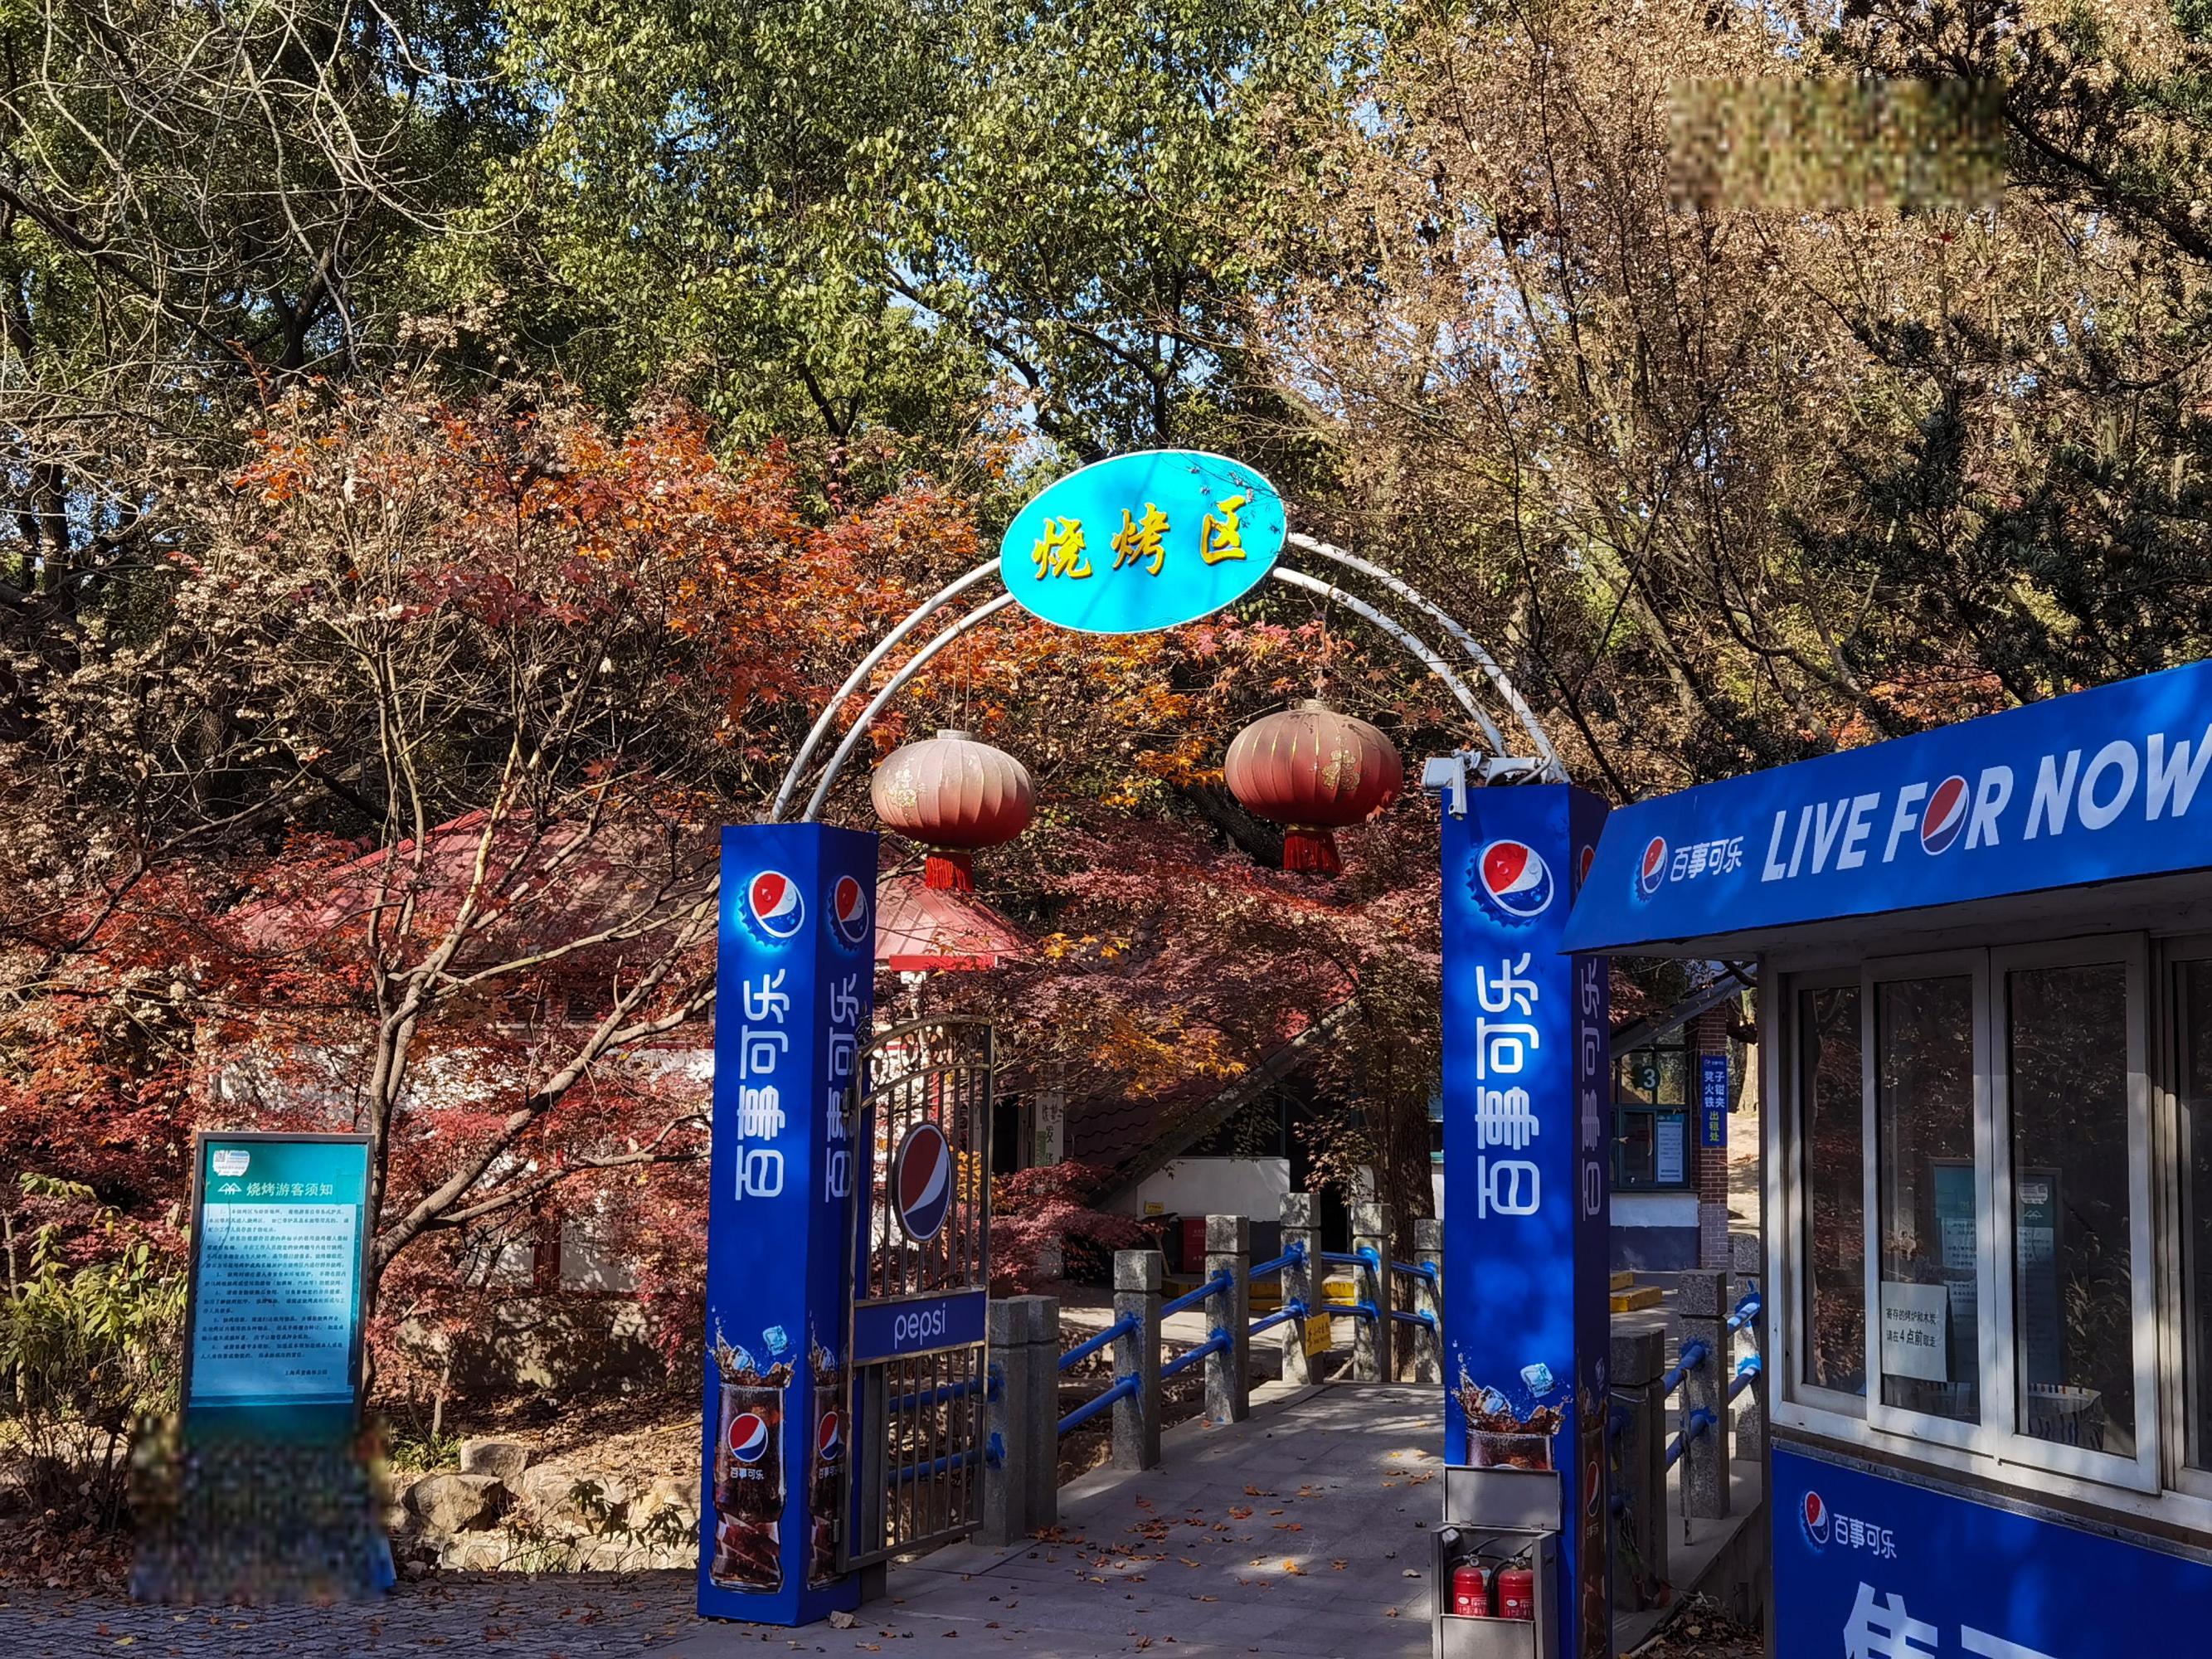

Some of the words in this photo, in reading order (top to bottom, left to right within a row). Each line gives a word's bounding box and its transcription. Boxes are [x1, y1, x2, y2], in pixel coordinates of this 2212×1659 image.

[1032, 495, 1247, 581] 烧烤区
[1761, 792, 1879, 883] LIVE
[1883, 766, 2013, 863] FOR
[2023, 723, 2212, 841] NOW
[1670, 836, 1744, 883] 百事可乐
[735, 968, 790, 1201] 百事可乐
[1475, 951, 1540, 1219] 百事可乐
[1580, 957, 1602, 1222] 百事可乐
[1643, 1069, 1656, 1088] 3
[1704, 1071, 1725, 1082] 凳子
[1704, 1097, 1725, 1109] 铁夹
[1709, 1111, 1720, 1141] 出租处
[246, 1182, 333, 1197] 烧烤游客须知
[894, 1301, 946, 1350] pepsi
[1885, 1307, 1937, 1325] 寄存的烤炉和木炭
[730, 1467, 765, 1481] 百事可乐
[1834, 1513, 1898, 1559] 百事可乐
